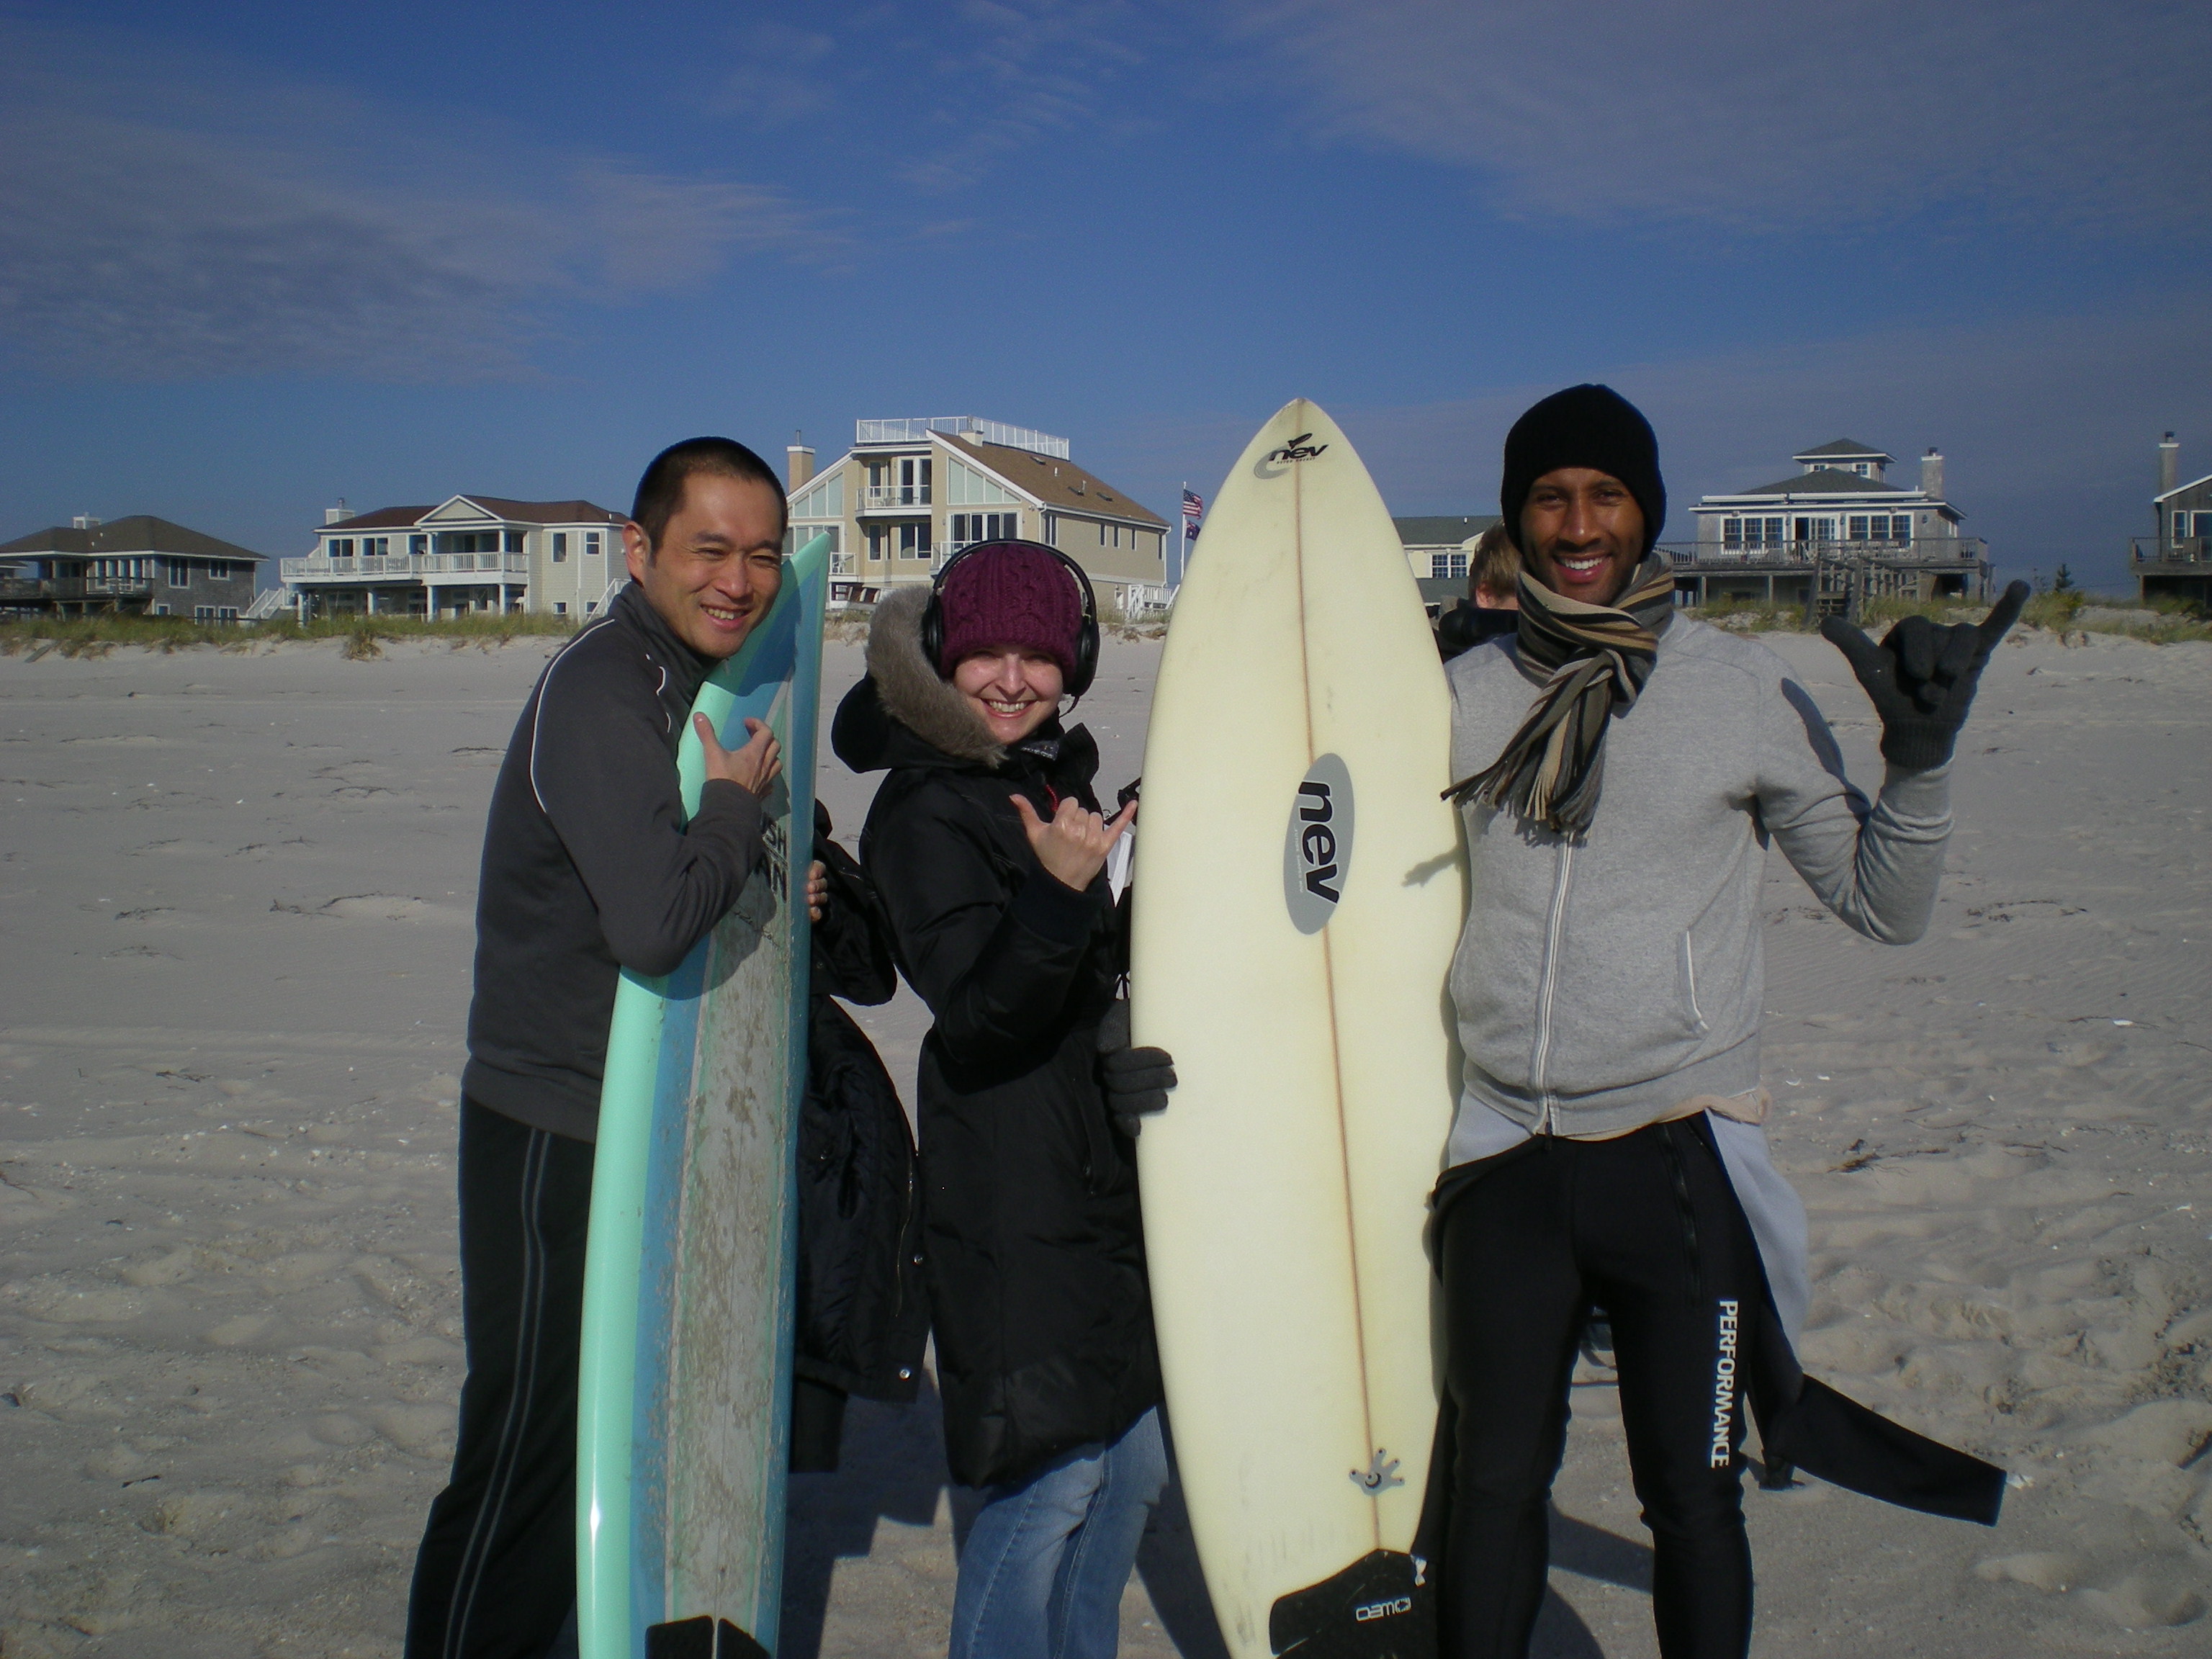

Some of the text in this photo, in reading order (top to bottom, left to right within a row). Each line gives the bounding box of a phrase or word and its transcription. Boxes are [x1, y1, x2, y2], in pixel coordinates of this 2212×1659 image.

[1268, 444, 1329, 462] nev
[1298, 781, 1340, 904] nev
[1710, 1300, 1739, 1469] PERFORMANCE
